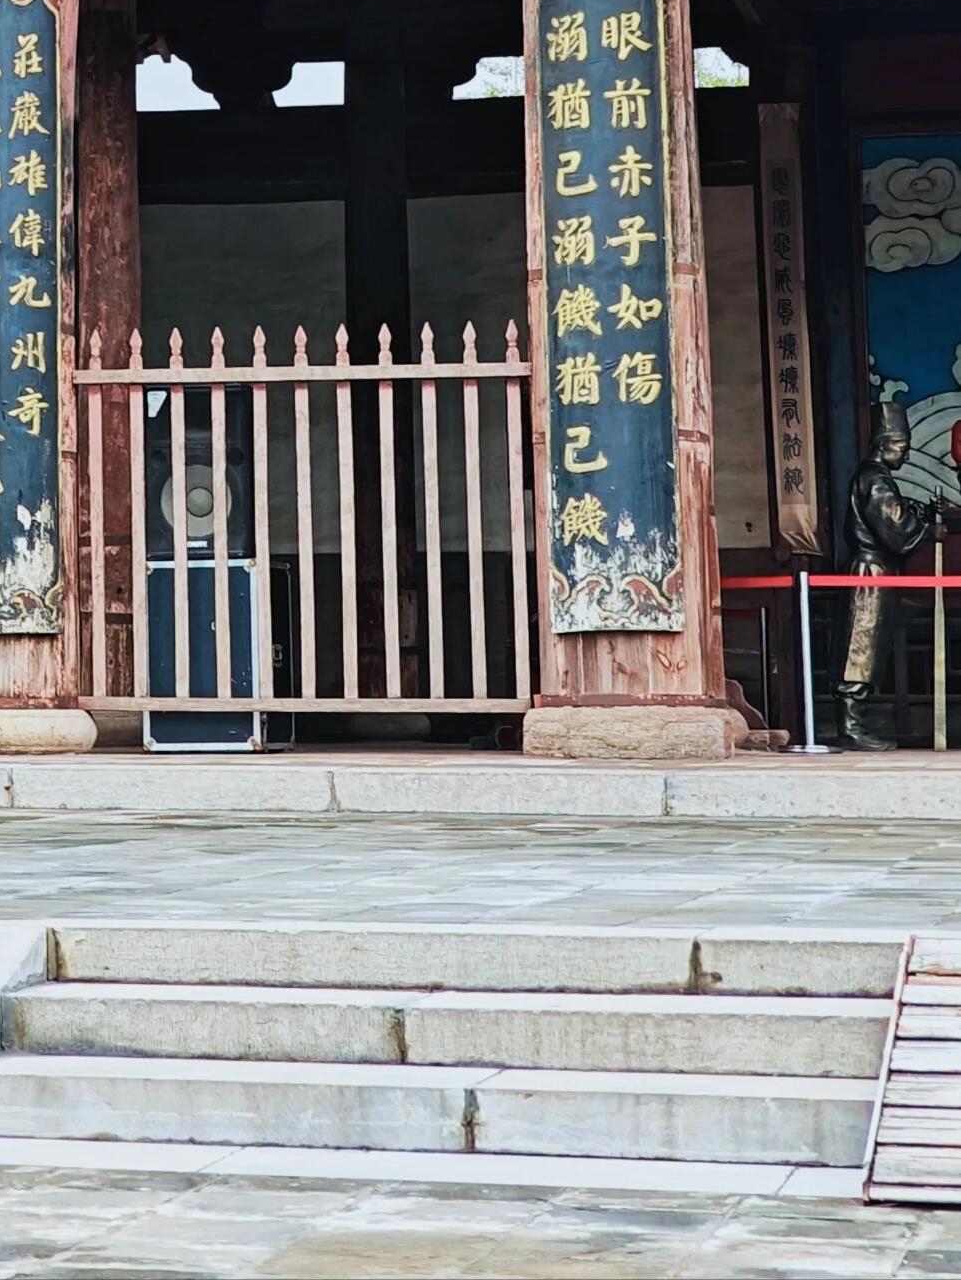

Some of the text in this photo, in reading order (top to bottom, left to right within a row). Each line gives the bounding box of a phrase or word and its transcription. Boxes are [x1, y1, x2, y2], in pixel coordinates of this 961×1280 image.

[601, 11, 663, 406] 眼前赤子如傷
